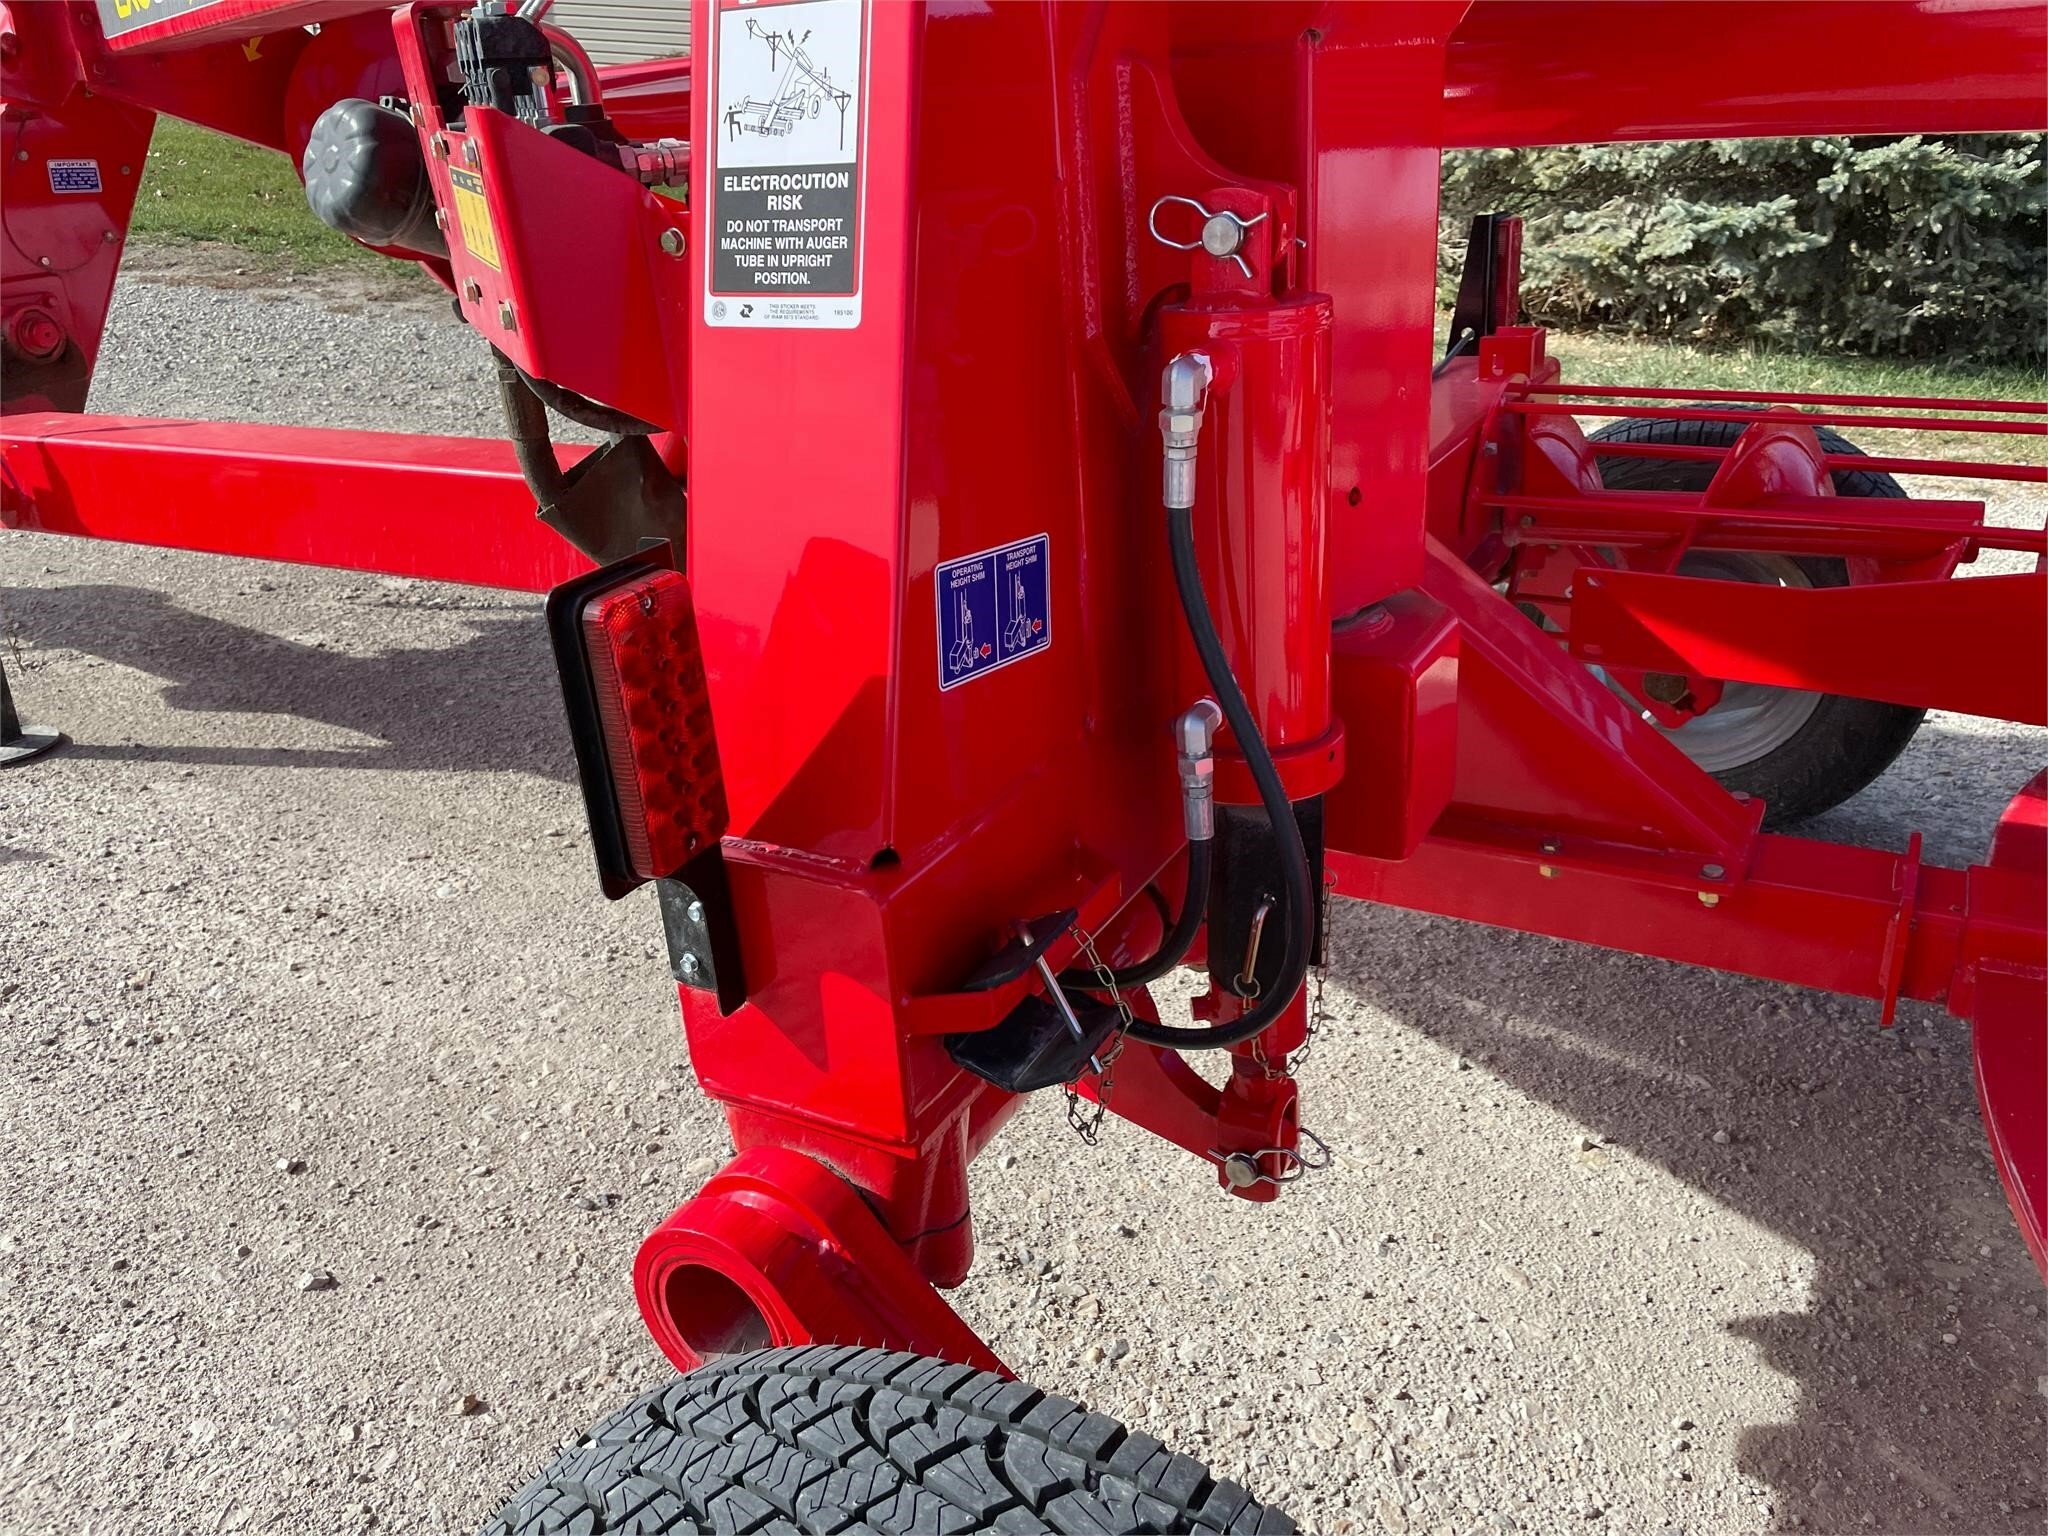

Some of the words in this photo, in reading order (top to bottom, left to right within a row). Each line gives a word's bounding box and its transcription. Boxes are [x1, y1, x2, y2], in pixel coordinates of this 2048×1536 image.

[724, 172, 849, 192] ELECTROCUTION
[767, 194, 803, 210] RISK
[726, 220, 743, 233] DO
[746, 220, 770, 232] NOT
[772, 218, 843, 232] TRANSPORT
[721, 238, 772, 250] MACHINE
[775, 237, 804, 250] WITH
[806, 236, 848, 249] AUGER
[734, 254, 764, 267] TUBE
[767, 254, 778, 267] IN
[782, 254, 832, 267] UPRIGHT
[754, 272, 811, 284] POSITION.
[1006, 545, 1036, 562] TRANSPORT
[952, 562, 984, 579] OPERATING
[1006, 558, 1024, 571] HEIGHT
[1025, 554, 1037, 565] SHIM
[950, 574, 971, 588] HEIGHT
[972, 571, 985, 582] SHIM
